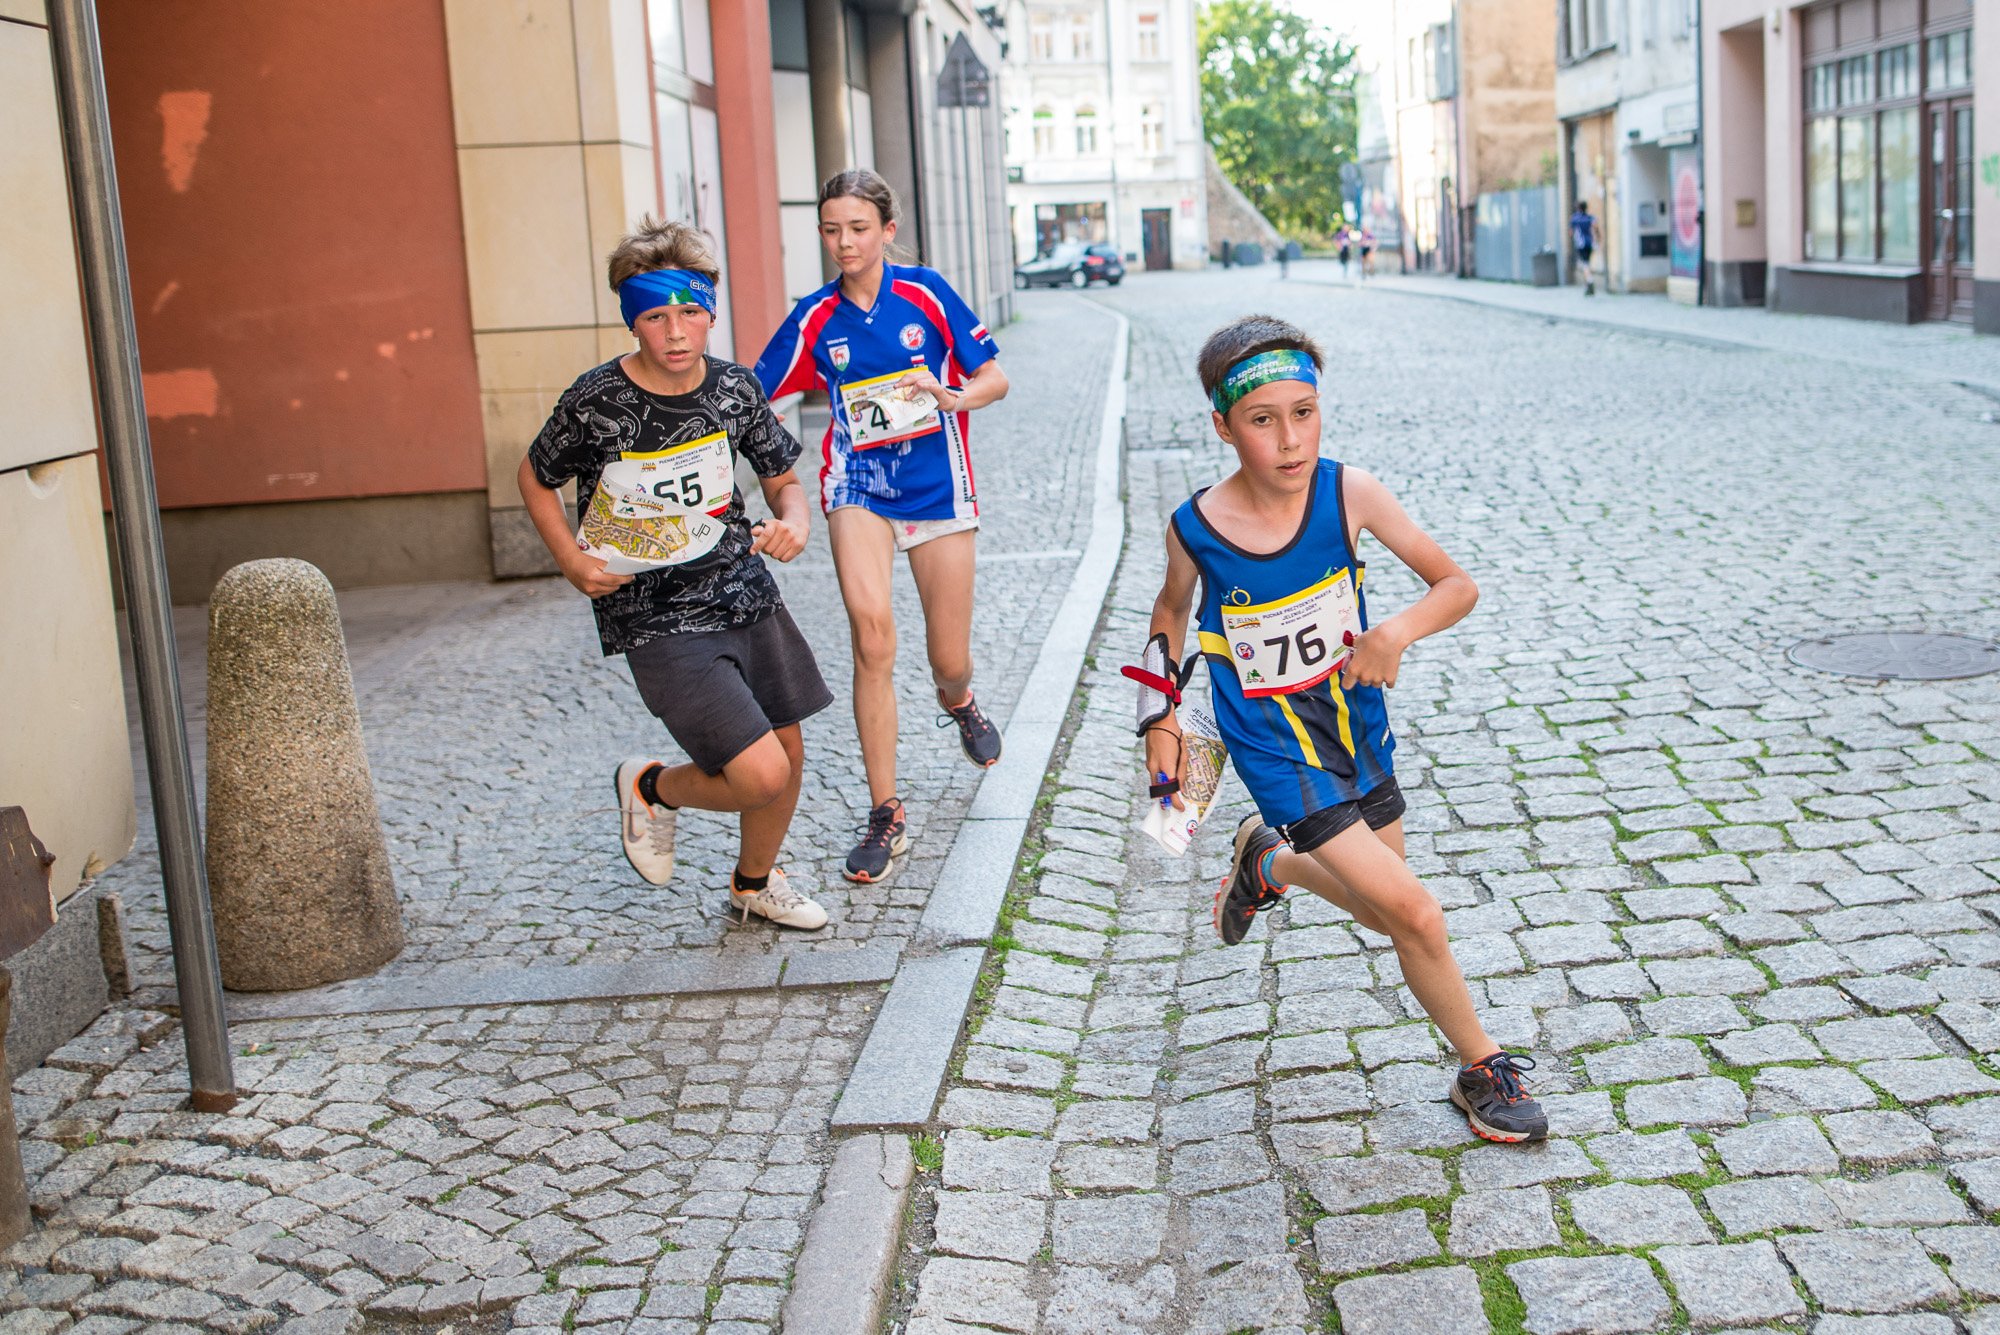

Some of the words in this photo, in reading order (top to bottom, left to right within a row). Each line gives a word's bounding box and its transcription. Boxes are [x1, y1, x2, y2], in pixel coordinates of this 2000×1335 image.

[1237, 360, 1278, 379] sportem
[1250, 371, 1262, 381] do
[870, 404, 890, 430] 4
[636, 497, 664, 508] JELENIA
[1263, 623, 1326, 676] 76
